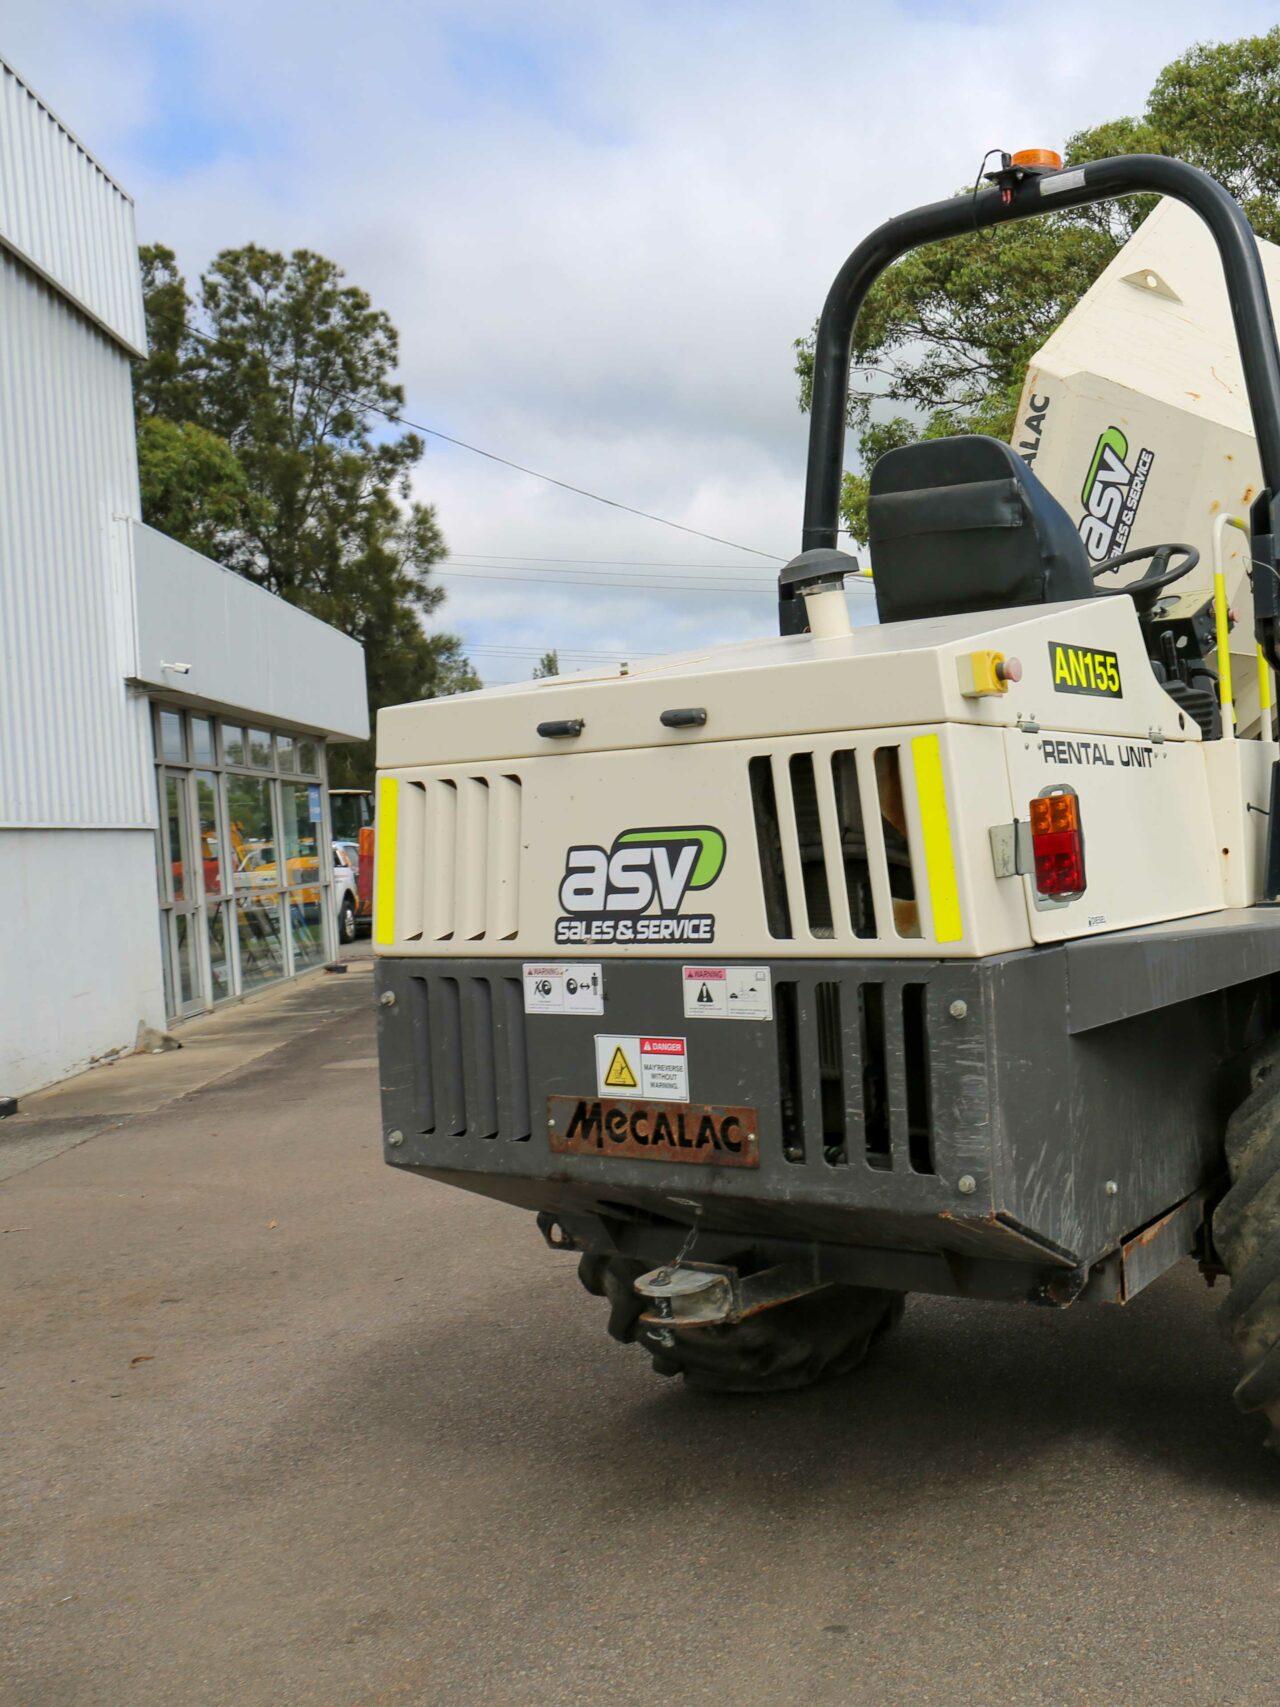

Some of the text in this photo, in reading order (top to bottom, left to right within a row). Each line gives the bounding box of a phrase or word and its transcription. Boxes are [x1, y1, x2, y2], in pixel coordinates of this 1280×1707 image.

[1019, 394, 1050, 472] ALAC
[1126, 450, 1153, 510] SERVICE
[1122, 510, 1135, 526] &
[1055, 646, 1120, 692] AN155
[1041, 740, 1153, 768] RENTAL UNIT
[616, 919, 634, 940] &
[636, 918, 712, 941] SERVICE
[694, 970, 723, 979] WARNING
[652, 1042, 682, 1052] DANGER
[643, 1063, 684, 1073] MAY REVERSE
[650, 1073, 678, 1081] WITHOUT
